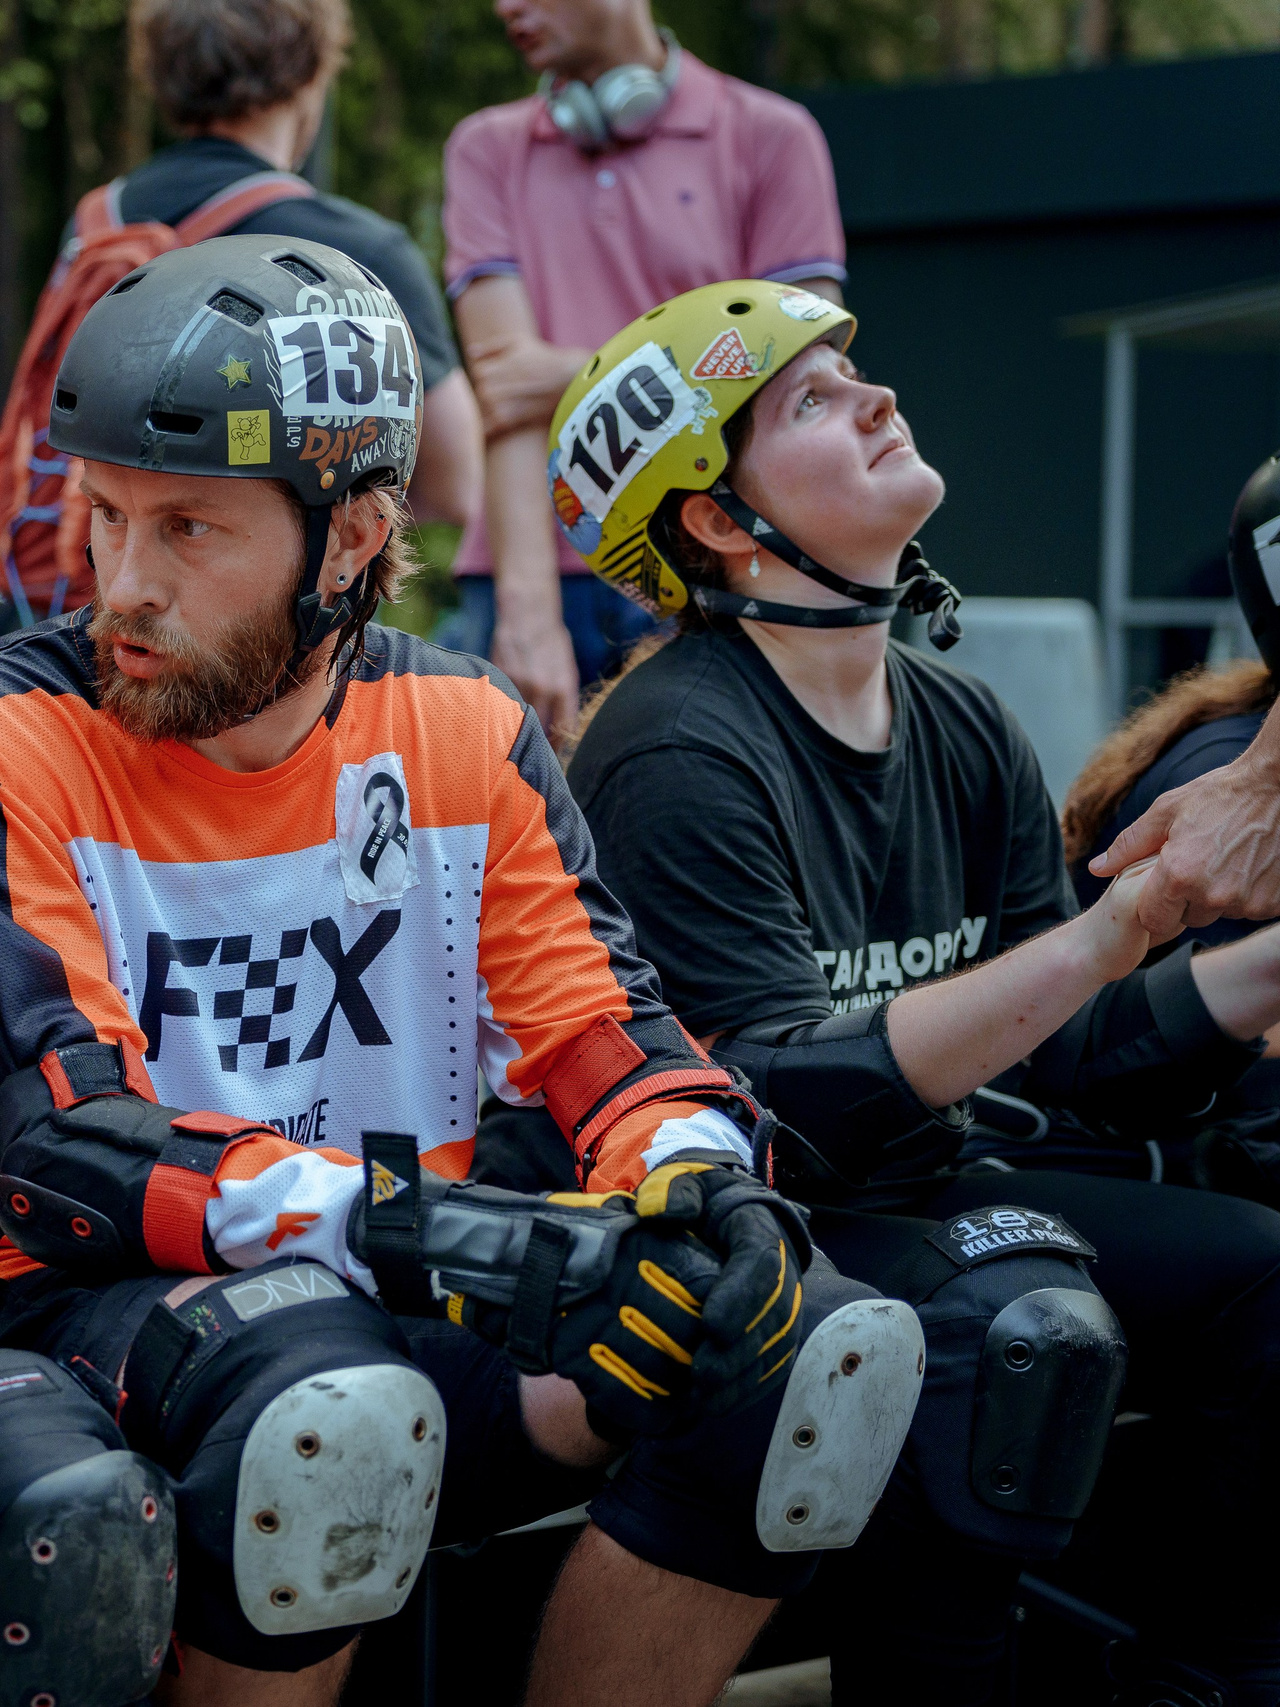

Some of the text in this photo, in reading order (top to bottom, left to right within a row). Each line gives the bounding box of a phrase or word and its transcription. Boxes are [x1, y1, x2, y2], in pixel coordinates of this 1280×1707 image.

[282, 320, 415, 407] 134
[702, 335, 738, 375] NEVER
[716, 345, 741, 375] GIVE
[299, 416, 378, 473] DAYS
[569, 365, 674, 495] 120
[351, 431, 388, 472] AWAY
[367, 842, 380, 858] RIDE
[378, 818, 392, 837] PEACE
[371, 1159, 397, 1206] K2
[956, 1210, 1056, 1240] 187
[960, 1228, 1080, 1258] KILLER PADS
[232, 1267, 342, 1314] DNA
